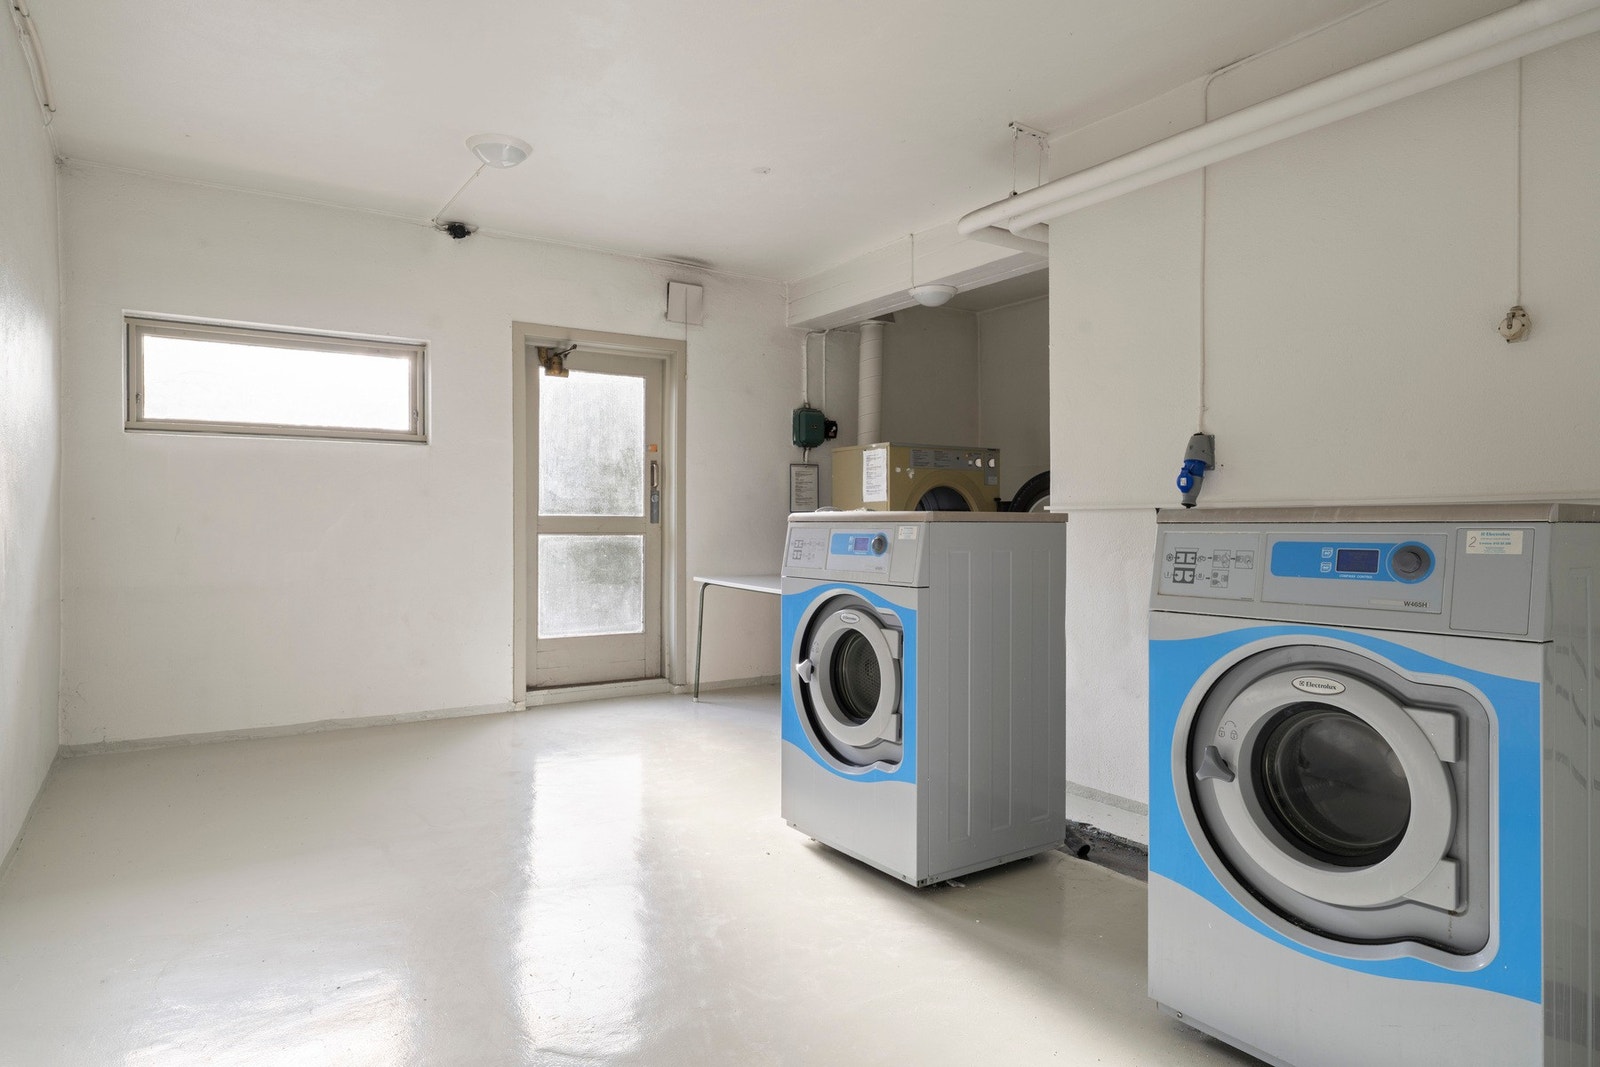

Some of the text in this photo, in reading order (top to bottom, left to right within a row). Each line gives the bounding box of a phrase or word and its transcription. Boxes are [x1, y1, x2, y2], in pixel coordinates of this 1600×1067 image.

[1468, 536, 1477, 548] 2
[1403, 600, 1428, 608] W465H
[1306, 681, 1337, 690] Electrolux
